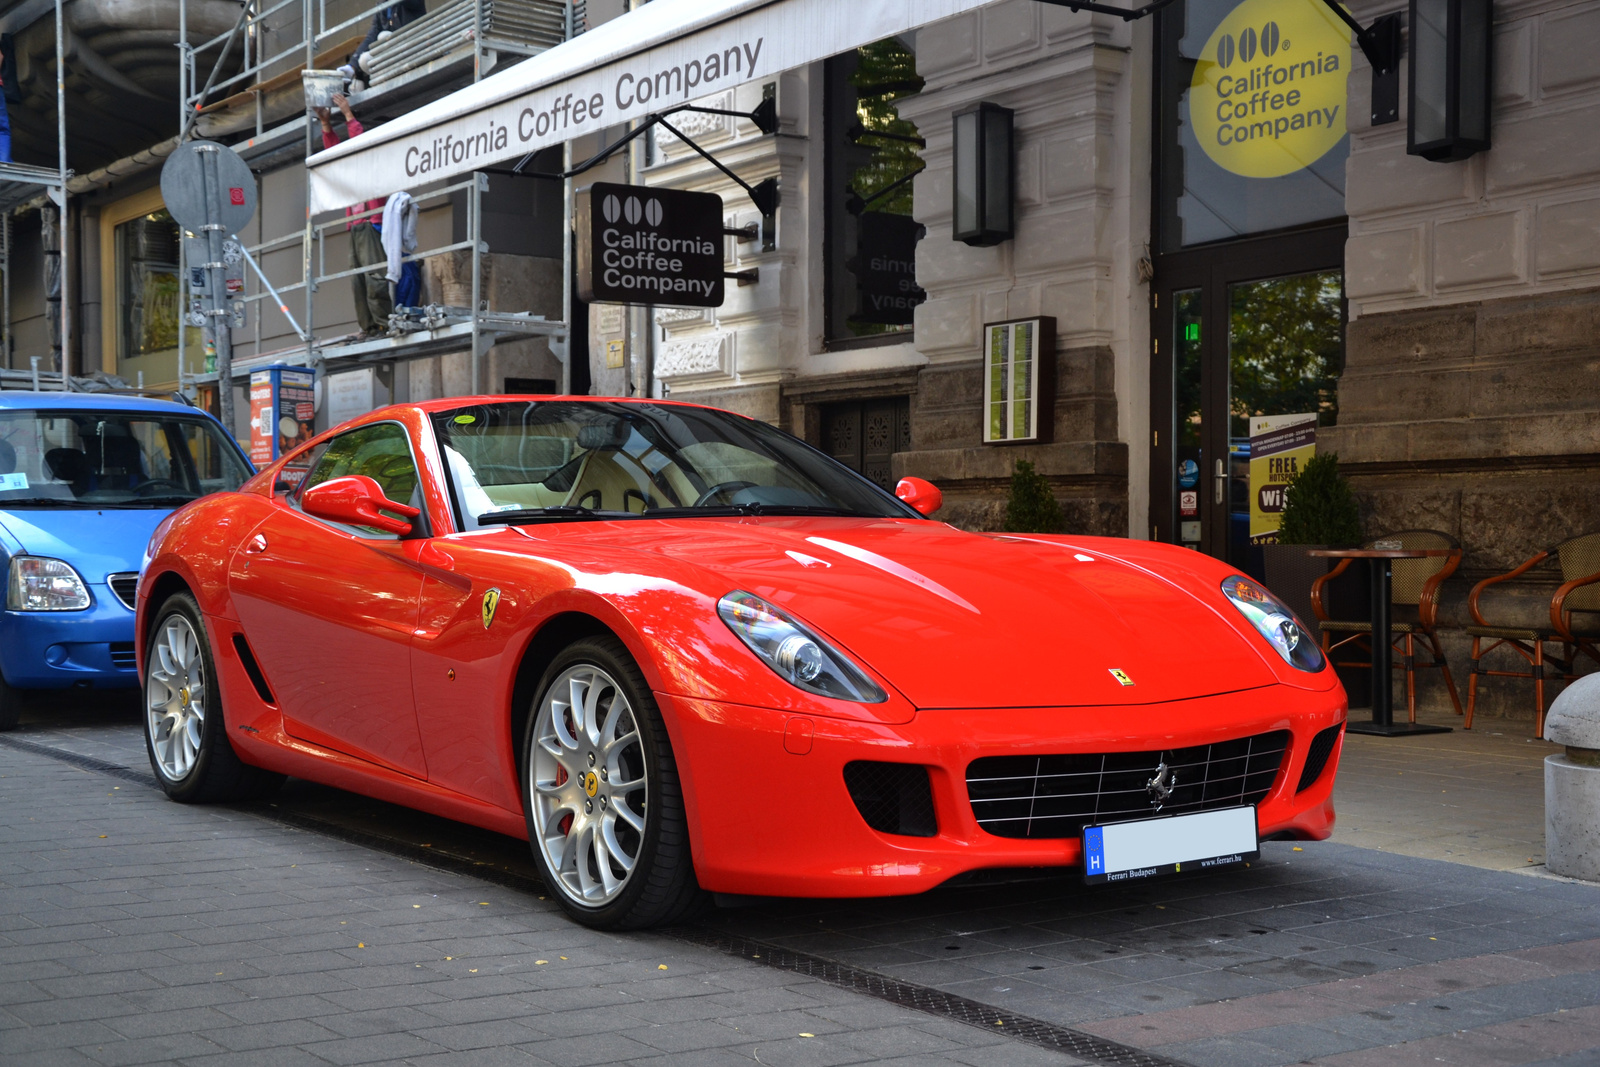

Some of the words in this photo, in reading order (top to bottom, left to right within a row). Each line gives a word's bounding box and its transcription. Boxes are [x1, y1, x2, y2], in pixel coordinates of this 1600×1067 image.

[1216, 51, 1339, 99] California
[405, 121, 508, 177] California
[518, 93, 604, 142] Coffee
[615, 37, 764, 110] Company
[1216, 89, 1301, 122] Coffee
[1216, 105, 1340, 146] Company
[602, 228, 715, 255] California
[602, 248, 683, 272] Coffee
[603, 268, 715, 297] Company
[1269, 457, 1297, 474] FREE
[1090, 855, 1100, 870] H
[1107, 871, 1128, 881] Ferrari
[1129, 868, 1157, 878] Budapest
[1201, 855, 1242, 867] www.ferrari.hu
